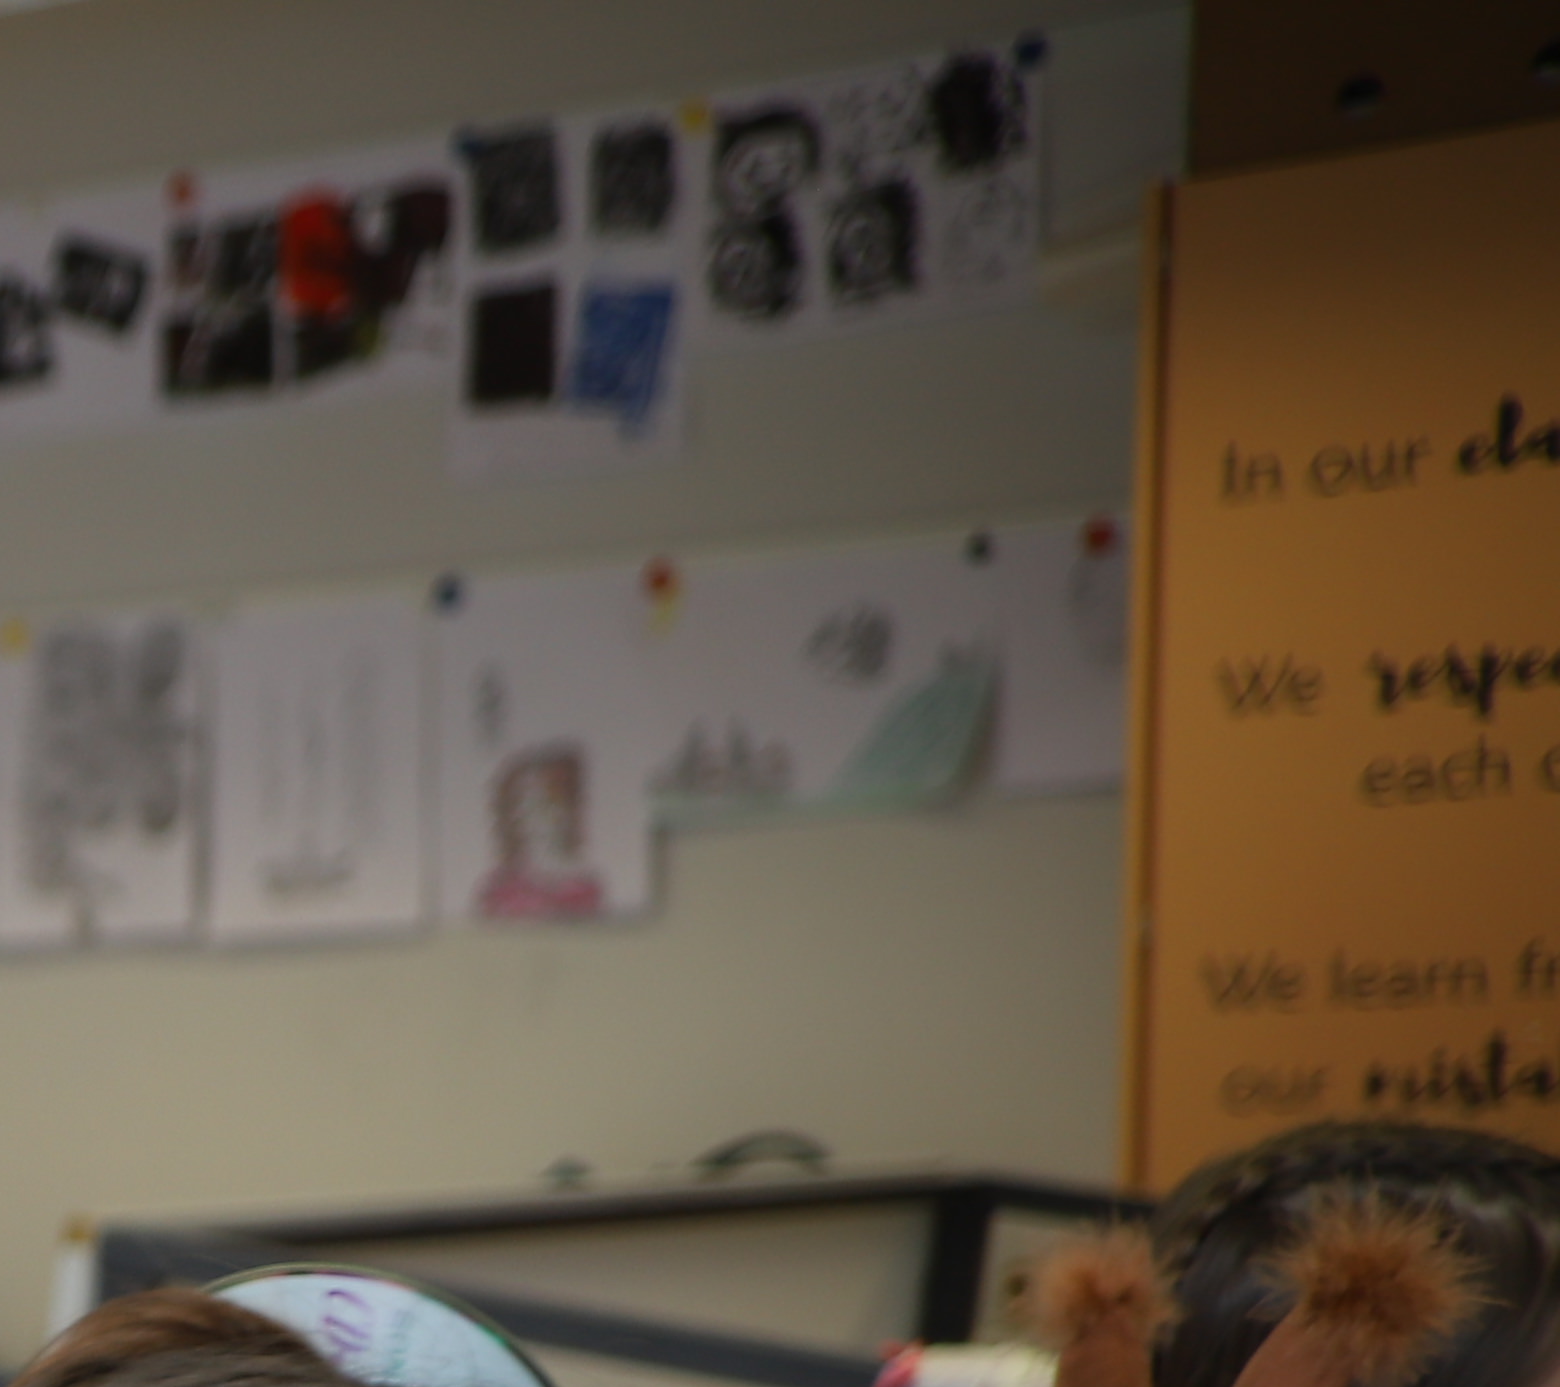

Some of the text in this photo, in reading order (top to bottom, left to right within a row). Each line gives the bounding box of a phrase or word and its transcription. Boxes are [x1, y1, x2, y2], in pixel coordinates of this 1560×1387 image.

[1219, 439, 1285, 500] In
[1307, 436, 1432, 497] our
[1212, 652, 1323, 717] We
[1360, 734, 1511, 806] each
[1200, 950, 1306, 1012] We
[1326, 943, 1489, 1009] learn
[1219, 1027, 1560, 1115] our mista
